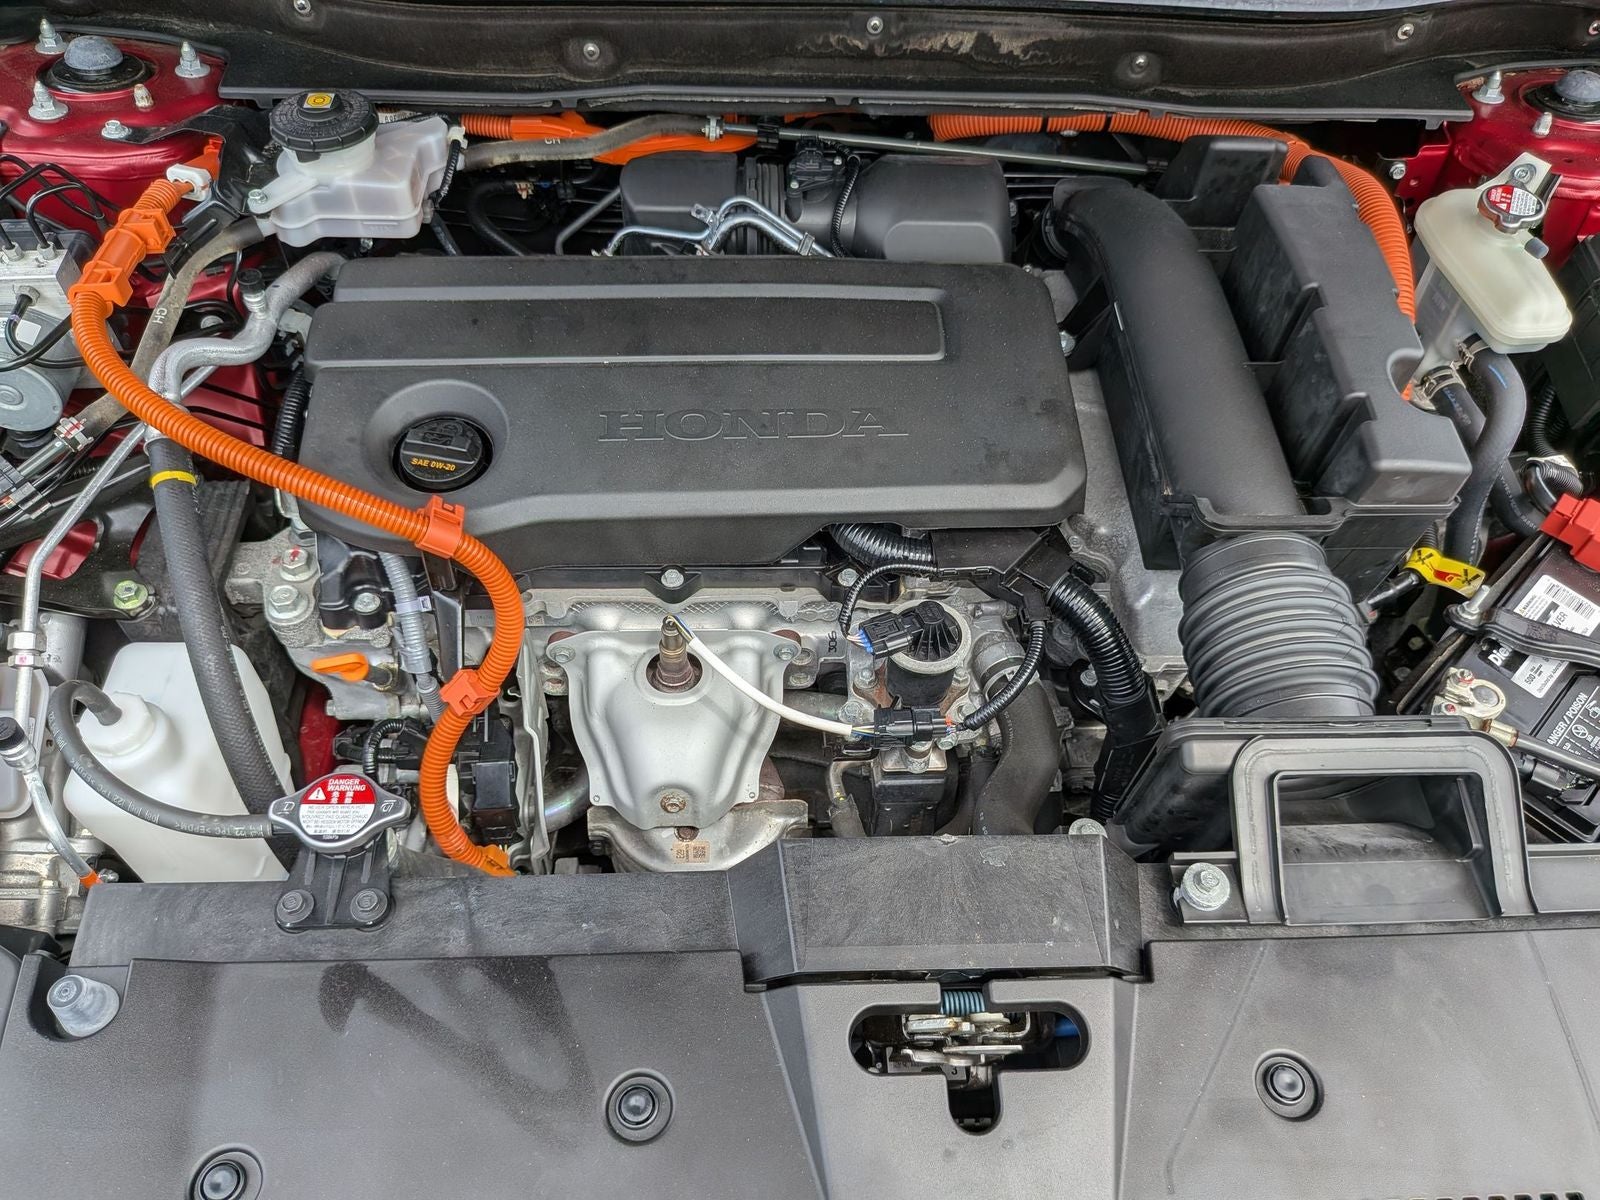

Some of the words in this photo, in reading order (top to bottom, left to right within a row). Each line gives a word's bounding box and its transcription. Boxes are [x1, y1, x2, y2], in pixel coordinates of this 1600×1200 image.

[598, 408, 909, 441] HONDA
[410, 457, 429, 467] SAE
[430, 460, 456, 472] 0W-20
[1546, 692, 1589, 746] ANGER/POISON
